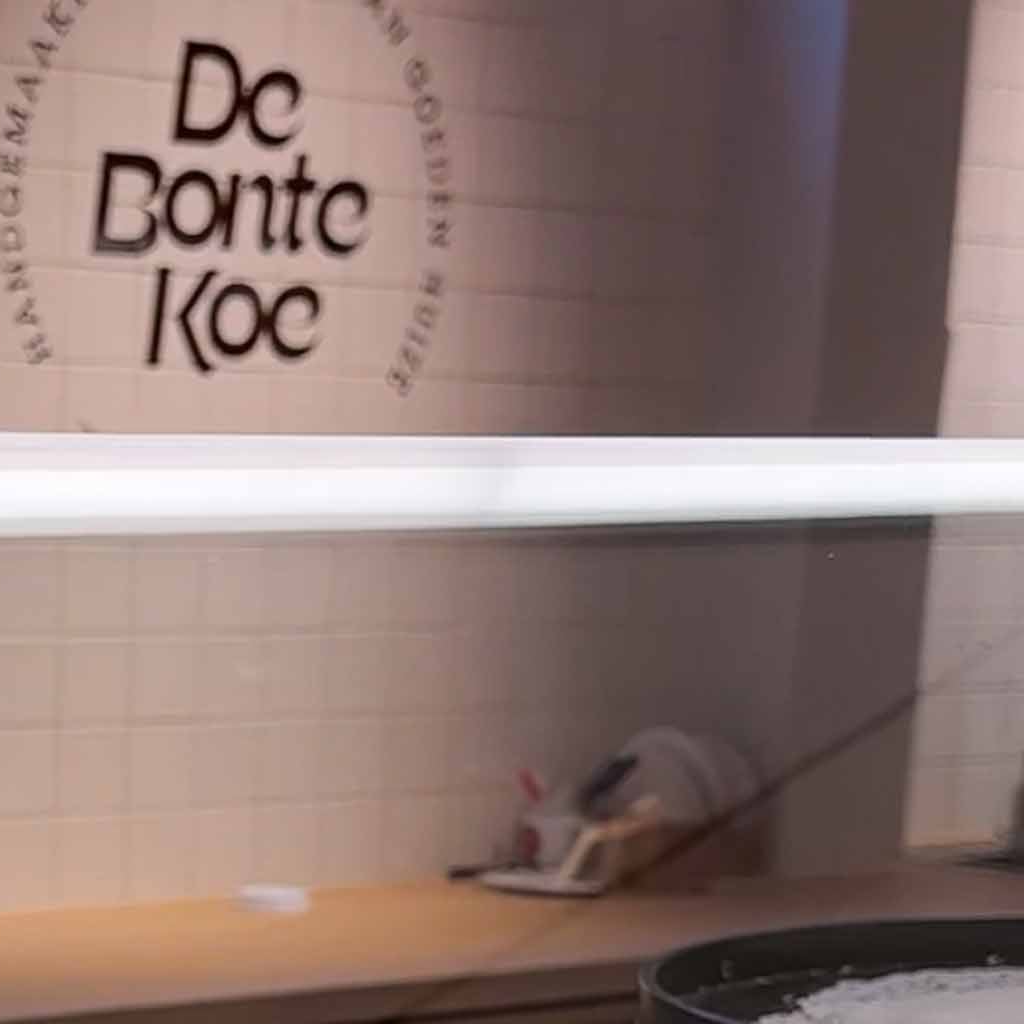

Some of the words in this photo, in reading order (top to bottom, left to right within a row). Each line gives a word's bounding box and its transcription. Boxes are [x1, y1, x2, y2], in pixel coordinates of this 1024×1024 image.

[173, 40, 303, 147] De
[93, 152, 370, 256] Bonte
[145, 267, 322, 374] Koe
